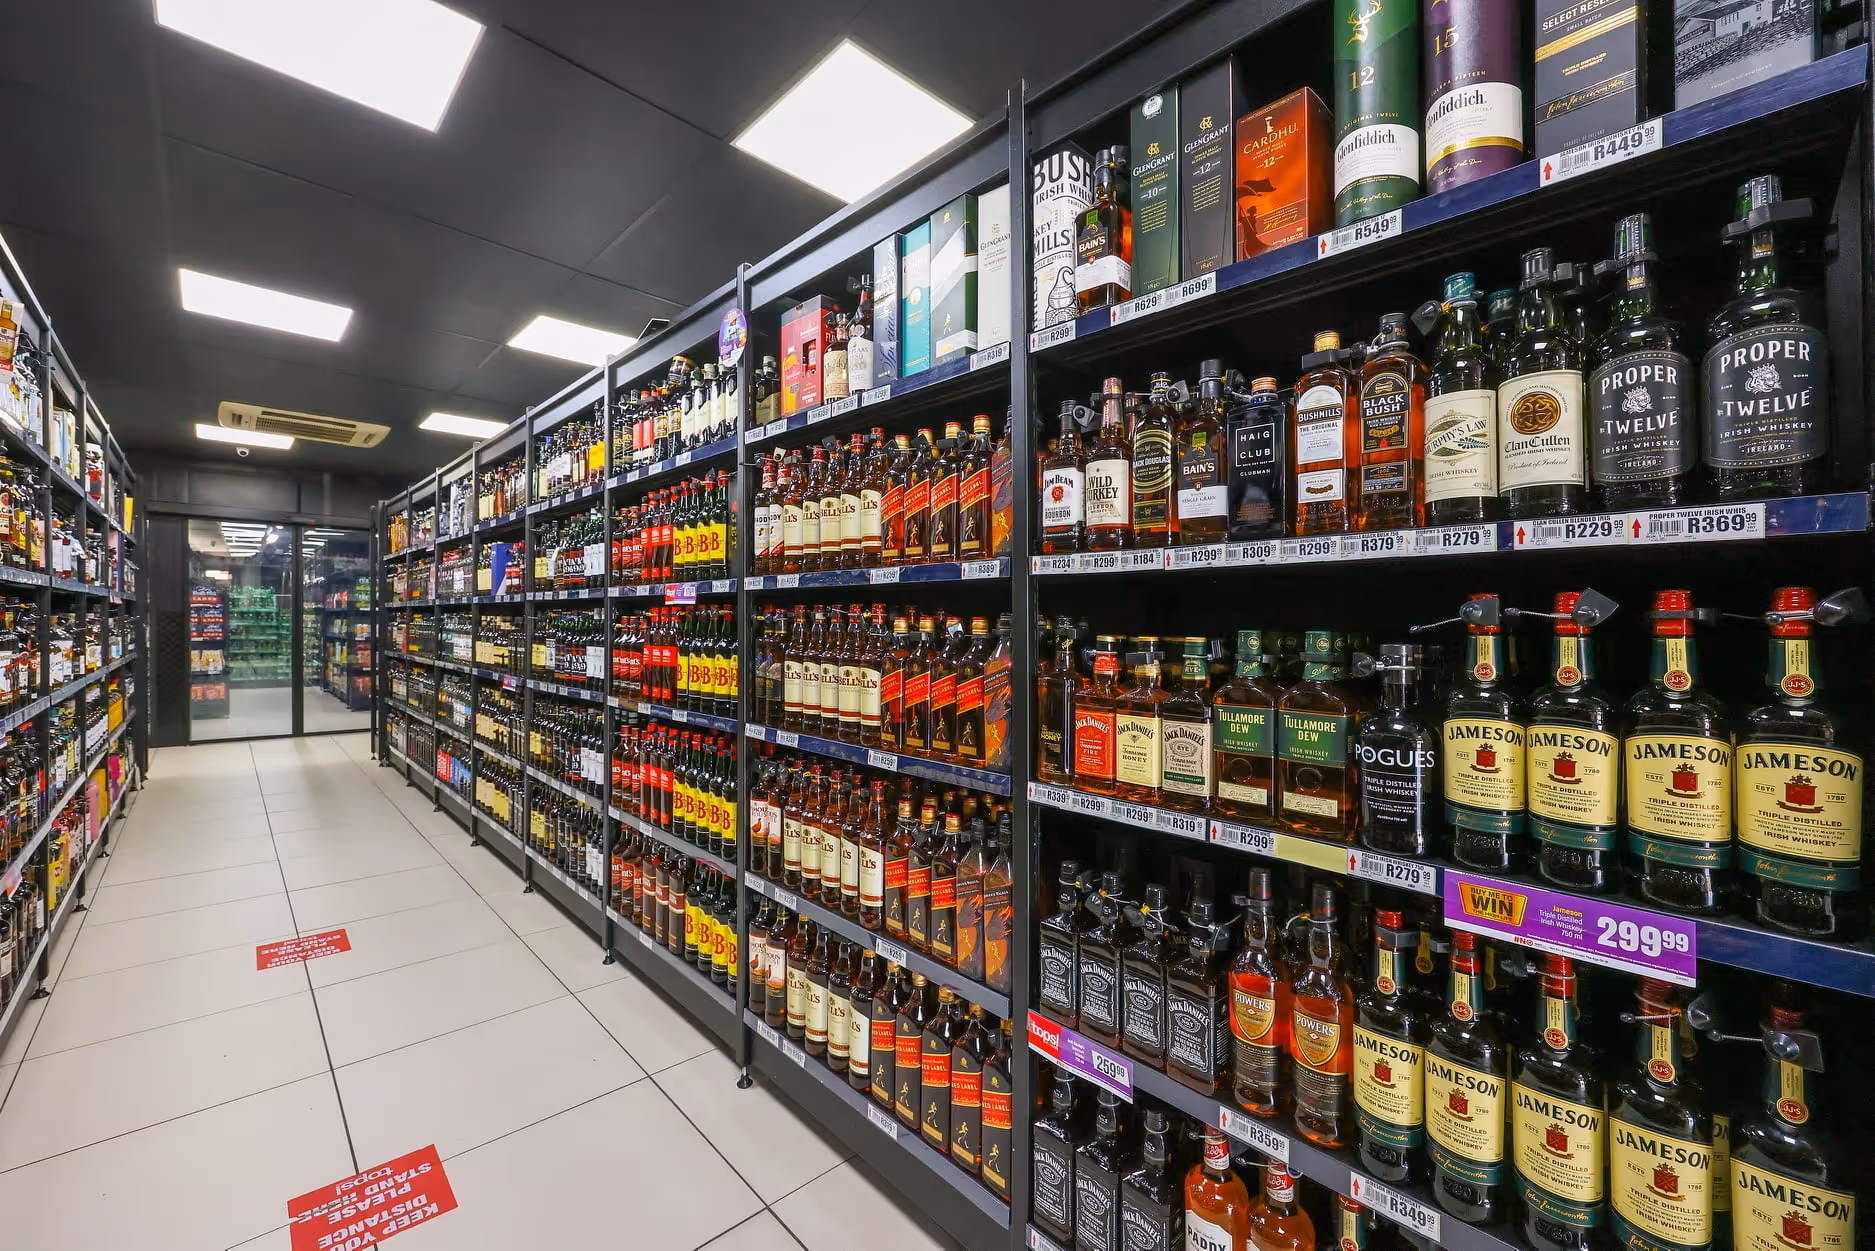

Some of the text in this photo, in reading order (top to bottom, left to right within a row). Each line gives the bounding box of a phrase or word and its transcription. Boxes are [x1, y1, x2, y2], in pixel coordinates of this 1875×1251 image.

[1542, 7, 1578, 31] SELECT
[1432, 25, 1459, 57] 15
[1351, 66, 1375, 90] 12
[1184, 123, 1229, 153] GLENGRANT
[1243, 122, 1298, 155] CARDHU
[1337, 128, 1396, 164] Glenfiddich
[1594, 132, 1644, 161] R449
[1132, 152, 1176, 177] GLENGRANT
[1200, 162, 1211, 175] 12
[1262, 156, 1275, 168] 12
[1036, 182, 1064, 205] IRISH
[1147, 188, 1158, 199] 10
[1355, 219, 1389, 241] R549
[1079, 235, 1105, 252] BAIN'S
[1182, 279, 1208, 297] R699
[1134, 296, 1158, 313] R629
[1050, 326, 1070, 343] R299
[1720, 340, 1811, 373] PROPER
[1602, 365, 1677, 395] PROPER
[1363, 393, 1405, 409] BLACK
[1366, 403, 1400, 416] BUSH
[1723, 389, 1811, 417] TWELVE
[1298, 407, 1342, 422] BUSHMILLS
[1605, 409, 1678, 434] TWELVE
[1311, 421, 1338, 431] ORIGINAL
[1466, 419, 1487, 433] LAW
[1720, 422, 1813, 439] IRISH WHISKEY
[1240, 430, 1270, 442] HAIG
[1239, 448, 1271, 459] CLUB
[1602, 440, 1681, 454] IRISH WHISKEY
[1746, 443, 1785, 454] IRELAND
[1144, 455, 1171, 466] DOUGLAS
[1183, 462, 1215, 475] BAIN'S
[1240, 468, 1271, 477] CLUBMAN
[1445, 467, 1478, 476] WHISKEY
[1055, 474, 1074, 488] BEAM
[1088, 475, 1113, 489] WILD
[1649, 507, 1746, 520] PROPER TWELVE IRISH WHIS
[1565, 520, 1624, 538] R229 99
[1688, 513, 1757, 534] R369 99
[1361, 537, 1394, 552] R379
[1442, 532, 1480, 547] R279
[1191, 549, 1217, 563] R299
[1243, 545, 1270, 558] R309
[1299, 542, 1330, 556] R299
[1052, 558, 1071, 569] R234
[1093, 556, 1115, 568] R299
[1133, 553, 1154, 565] R184
[1075, 716, 1110, 733] JACK DANIEL'S
[1218, 708, 1265, 725] TULLAMORE
[1283, 714, 1337, 733] TULLAMORE
[1117, 721, 1155, 740] JACK DANIEL'S
[1230, 723, 1249, 734] DEW
[1298, 729, 1319, 742] DEW
[1449, 725, 1524, 746] JAMESON
[1164, 728, 1206, 747] JACK DANIEL'S
[1528, 732, 1610, 757] JAMESON
[1122, 754, 1148, 763] HONEY
[1355, 743, 1435, 768] POGUES
[1634, 743, 1729, 768] JAMESON
[1743, 752, 1858, 783] JAMESON
[1364, 775, 1422, 789] TRIPLE DISTILLED
[1367, 784, 1419, 797] IRISH WHISKEY
[1047, 790, 1066, 803] R339
[1080, 798, 1101, 812] R299
[1648, 797, 1720, 810] TRIPLE DISTILLED
[1126, 808, 1149, 823] R299
[1653, 816, 1716, 829] IRISH WHISKEY
[1758, 810, 1842, 828] TRIPLE DISTILLED
[1172, 817, 1195, 832] R319
[1240, 831, 1268, 849] R299
[1764, 831, 1837, 847] IRISH WHISKEY
[1386, 863, 1420, 884] R279
[1470, 887, 1513, 901] BUY ME TO
[1471, 893, 1514, 917] WIN
[1553, 905, 1583, 918] Jameson
[1539, 909, 1583, 925] Triple Distilled
[1540, 918, 1583, 934] Irish Whiskey
[1561, 929, 1583, 940] 750 ml
[1597, 916, 1662, 957] 299
[1662, 928, 1689, 952] 99
[1080, 961, 1115, 985] JACK DANIEL'S
[1124, 978, 1162, 1003] JACK DANIEL'S
[1235, 993, 1271, 1012] POWERS
[1168, 999, 1210, 1026] JACK DANIEL'S
[1031, 1020, 1059, 1048] tops!
[1296, 1015, 1337, 1037] POWERS
[1355, 1032, 1419, 1066] JAMESON
[930, 1064, 948, 1072] LABEL
[1096, 1056, 1116, 1078] 259
[1426, 1061, 1499, 1099] JAMESON
[991, 1102, 1010, 1112] LABEL
[1516, 1092, 1600, 1133] JAMESON
[1250, 1126, 1279, 1151] R359
[1616, 1128, 1711, 1171] JAMESON
[335, 1167, 394, 1195] tops!
[364, 1162, 433, 1195] STAND
[328, 1183, 412, 1225] PLEASE
[1738, 1171, 1851, 1222] JAMESON
[382, 1202, 439, 1235] KEEP
[1389, 1197, 1427, 1228] R349
[318, 1193, 428, 1250] DISTANCE
